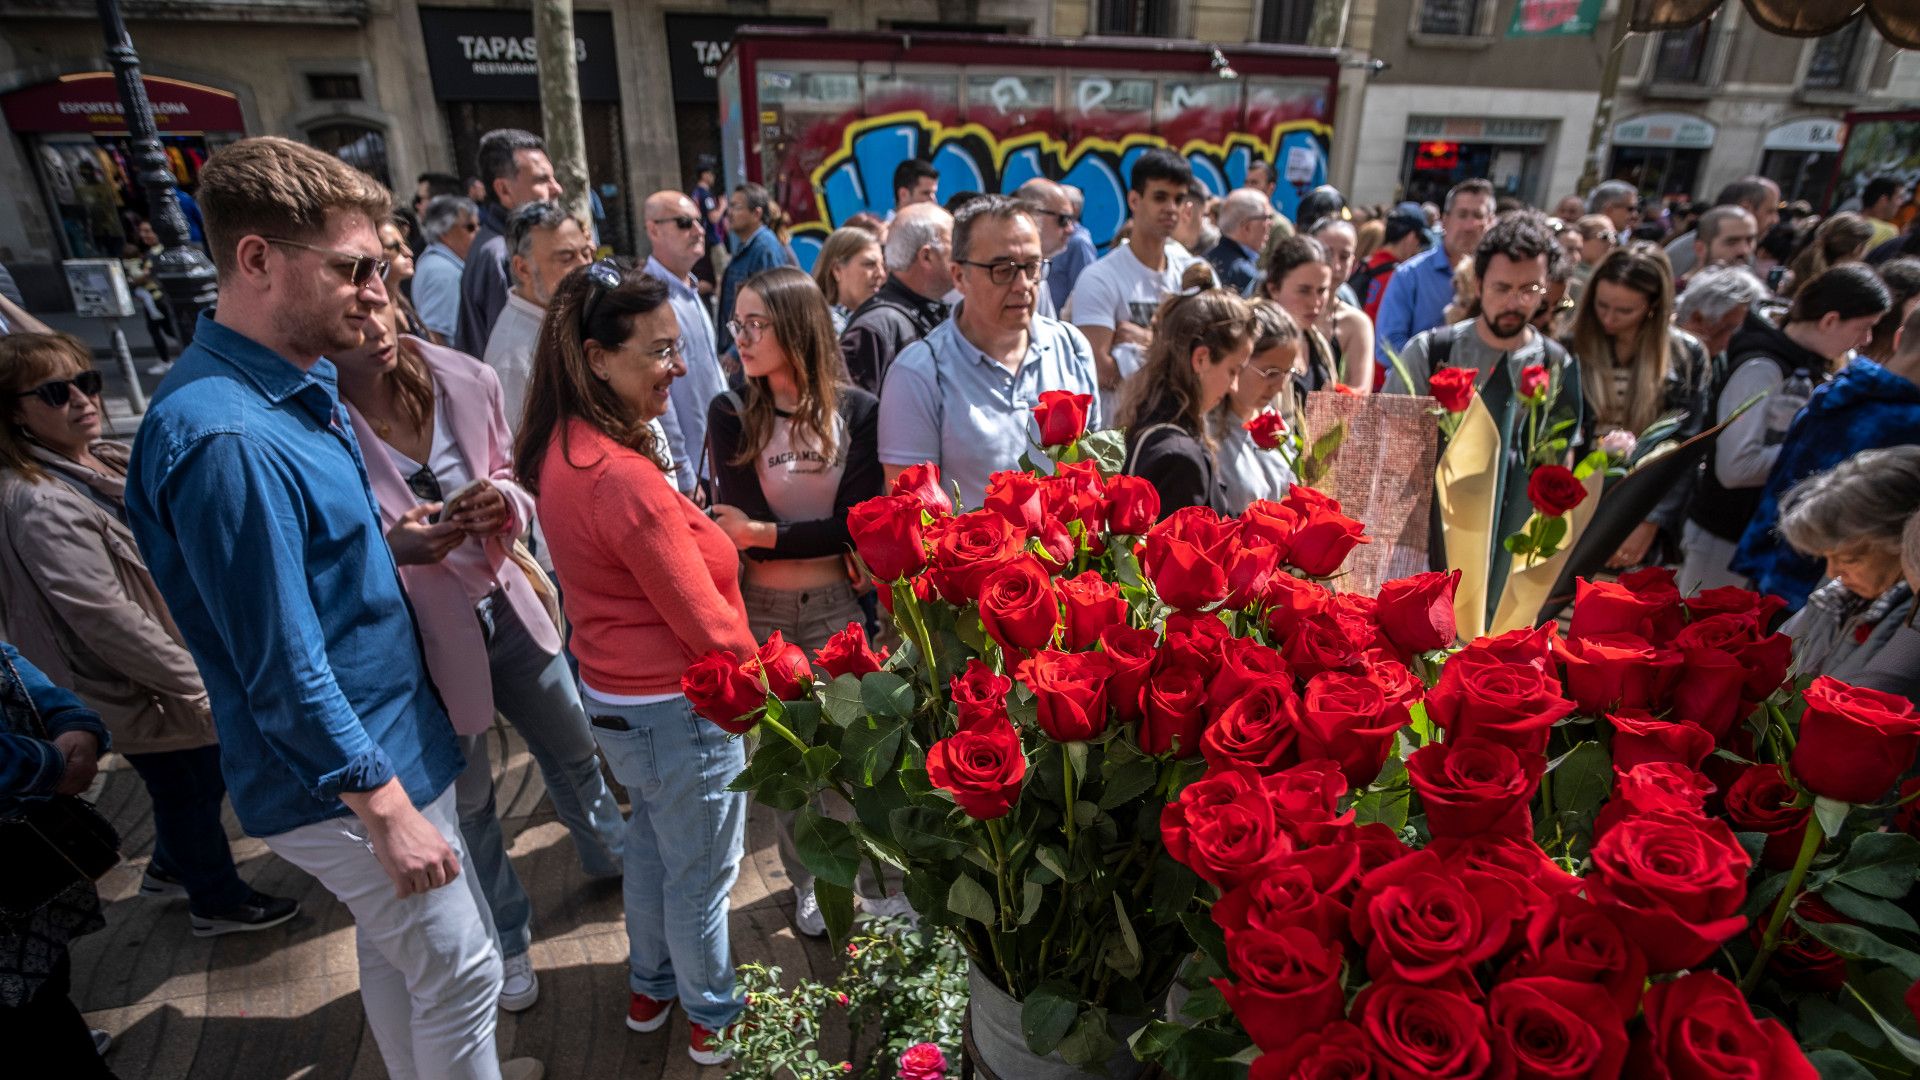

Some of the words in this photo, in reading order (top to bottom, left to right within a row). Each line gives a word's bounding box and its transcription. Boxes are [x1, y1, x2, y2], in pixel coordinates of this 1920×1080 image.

[457, 36, 538, 61] TAPAS
[472, 62, 538, 74] RESTAURAN
[114, 102, 190, 115] BLONA
[767, 450, 839, 468] SACRAMEN
